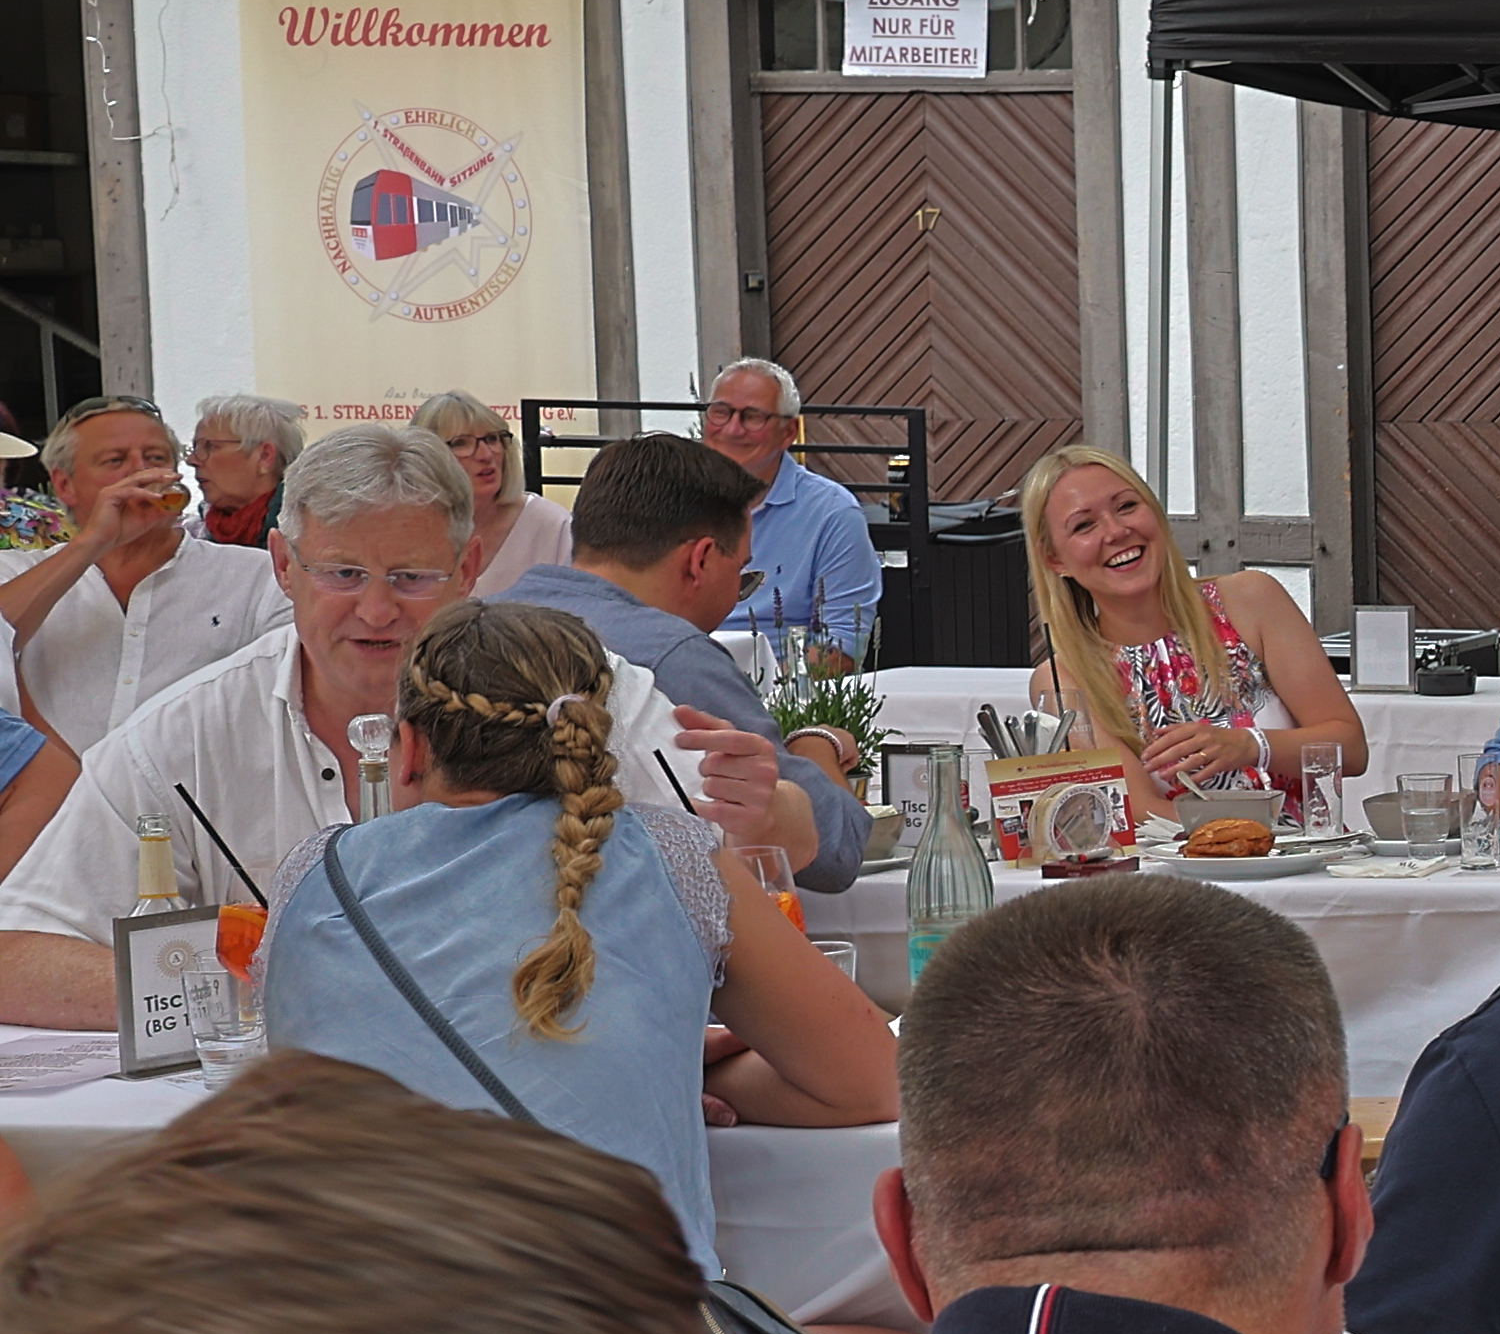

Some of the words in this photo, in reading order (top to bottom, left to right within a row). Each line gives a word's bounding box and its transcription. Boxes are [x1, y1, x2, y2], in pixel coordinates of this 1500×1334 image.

[278, 6, 552, 48] Willkommen
[873, 17, 912, 35] NUR
[919, 14, 955, 36] FÜR
[849, 45, 979, 65] MITARBEITER!
[404, 110, 478, 139] EHRLICH
[449, 152, 495, 188] SITZUNG
[321, 165, 351, 274] NACHHALTIG
[915, 208, 941, 230] 17
[413, 262, 517, 321] AUTHENTISCH
[314, 405, 328, 420] 1.
[557, 406, 577, 421] e.V.
[901, 800, 926, 814] Tisc
[143, 994, 183, 1014] Tisc
